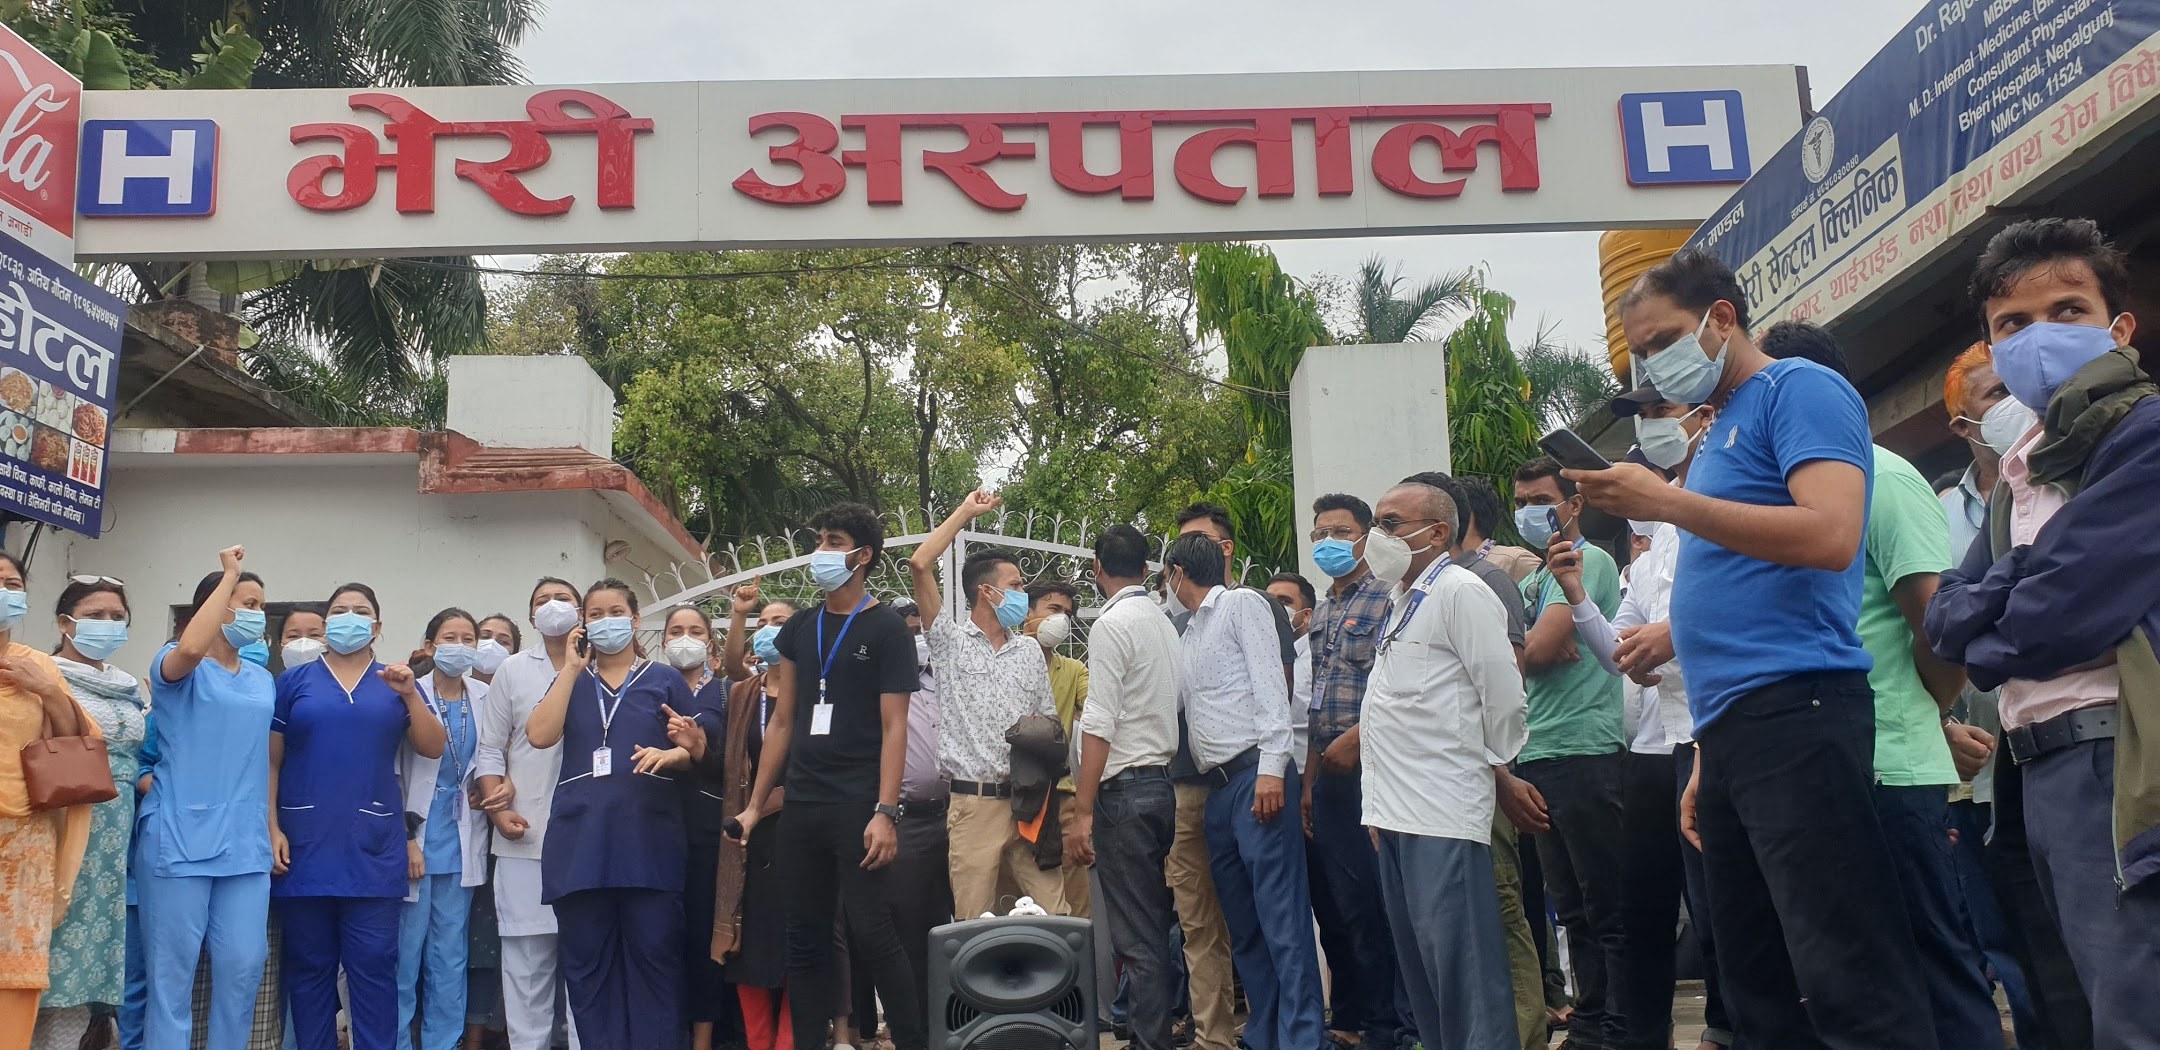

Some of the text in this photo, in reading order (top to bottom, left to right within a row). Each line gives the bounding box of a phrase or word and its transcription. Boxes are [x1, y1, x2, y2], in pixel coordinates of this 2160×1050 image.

[1915, 25, 1937, 54] Dr.
[1983, 0, 2019, 28] MBB
[1908, 100, 1922, 119] M.
[1922, 87, 1933, 103] D.
[1934, 51, 1975, 98] Internal
[1978, 10, 2031, 61] Medicine
[1958, 2, 2114, 132] Bheri Hospital, Nepalgunj
[1968, 36, 2032, 97] Consultant
[1990, 56, 2084, 137] NMC No. 11524
[0, 83, 70, 191] la
[98, 129, 195, 205] H
[287, 92, 1552, 217] भेरी अस्पताल
[1643, 99, 1735, 173] H
[1950, 164, 1994, 214] तथा
[1999, 130, 2043, 181] बाथ
[2051, 91, 2099, 146] रोग
[2107, 48, 2160, 111] विषे
[1707, 199, 1745, 247] मण्डल
[1819, 155, 1898, 252] क्लिनिक
[0, 280, 115, 399] होटल
